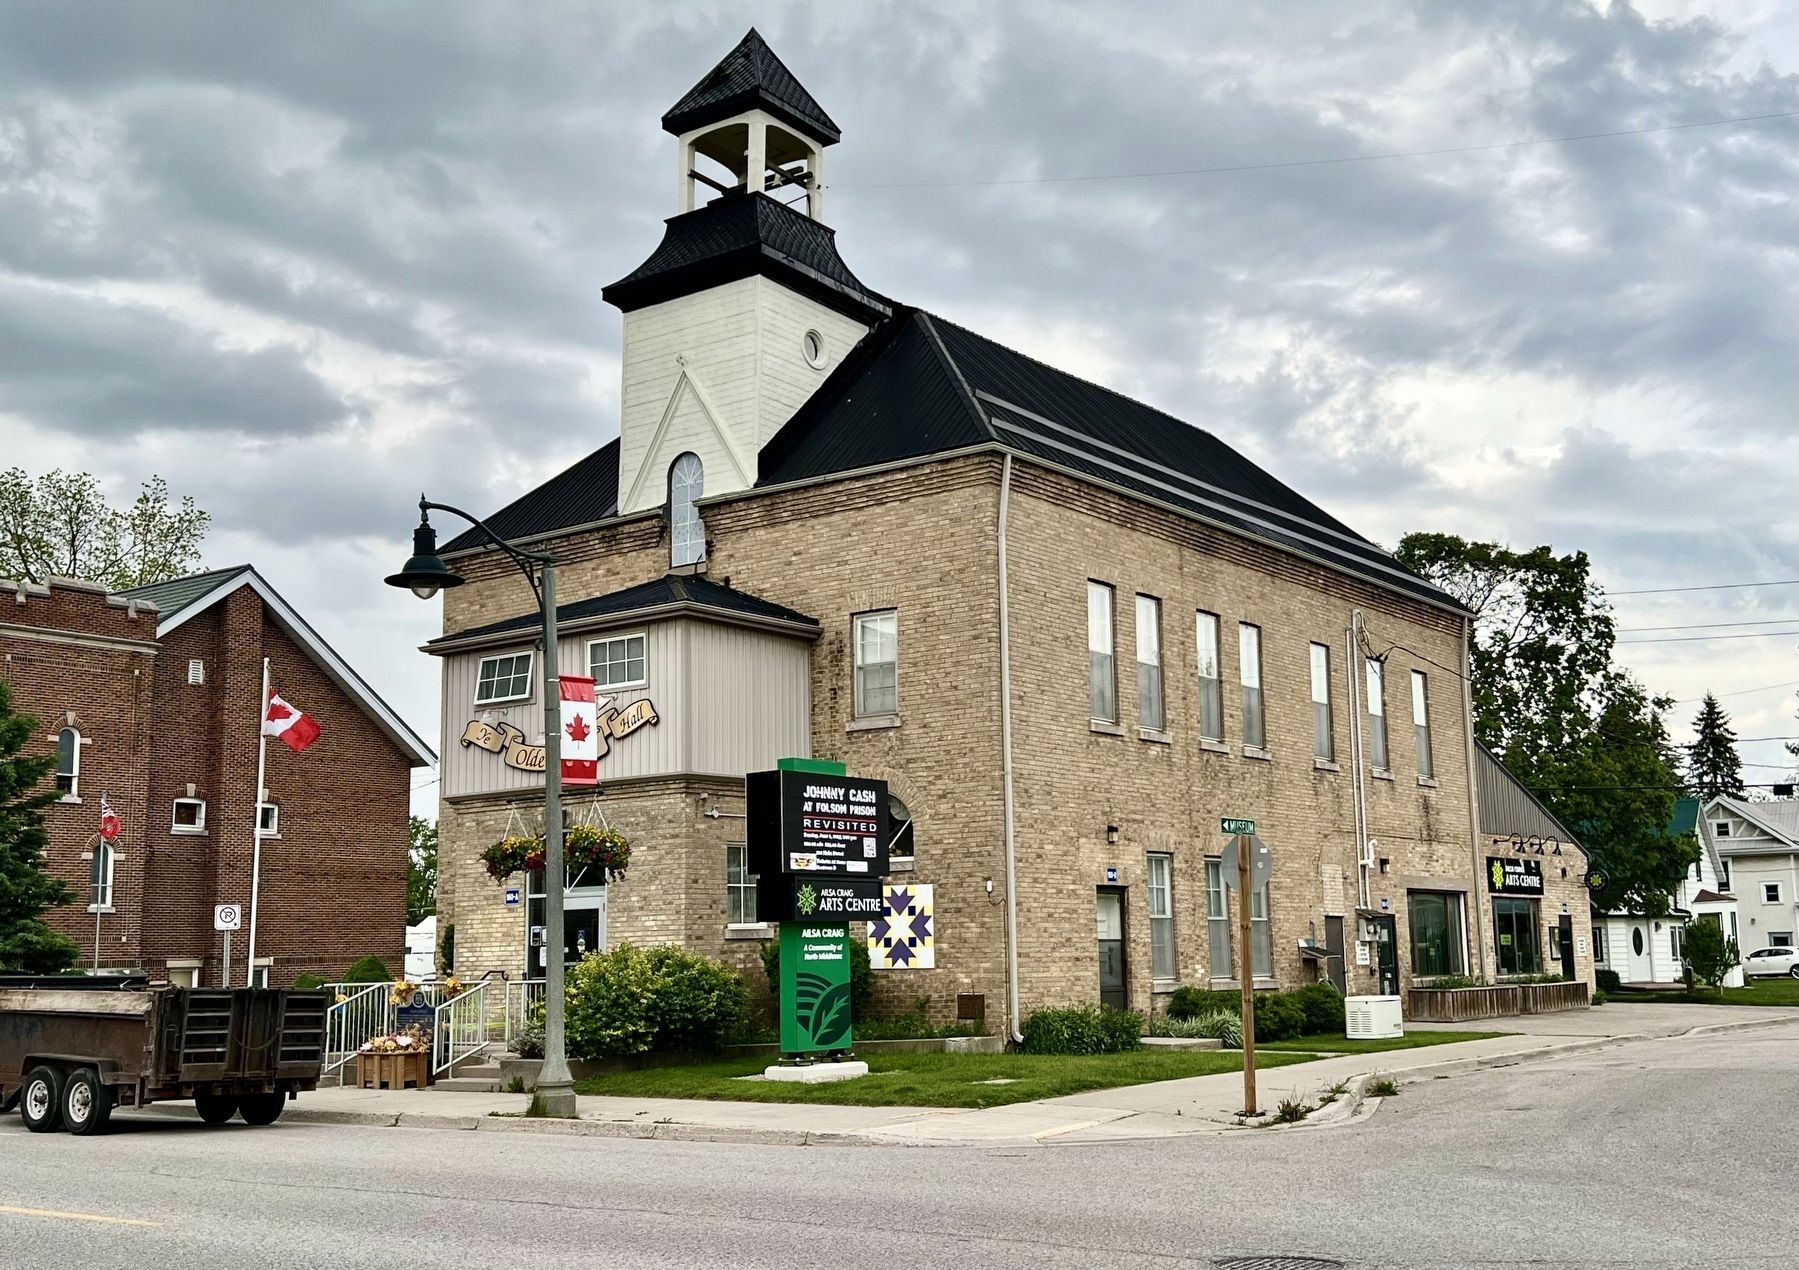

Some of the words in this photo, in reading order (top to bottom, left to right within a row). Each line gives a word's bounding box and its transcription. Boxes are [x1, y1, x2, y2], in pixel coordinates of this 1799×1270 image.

[475, 727, 491, 745] Ye
[515, 749, 545, 768] Olde
[619, 704, 644, 734] Hall
[802, 785, 845, 801] JOHNNY
[849, 789, 876, 804] CASH
[803, 801, 814, 812] AT
[816, 802, 847, 815] FOLSOM
[849, 804, 877, 816] PRISON
[803, 818, 877, 832] REVISITED
[1229, 820, 1254, 833] MUSEUM
[1520, 874, 1541, 888] CENTRE
[820, 888, 836, 897] AILSA
[836, 889, 854, 897] CRAIG
[819, 897, 843, 911] ARTS
[845, 898, 881, 912] CENTRE
[802, 928, 821, 938] AILSA
[822, 928, 845, 938] CRAIG
